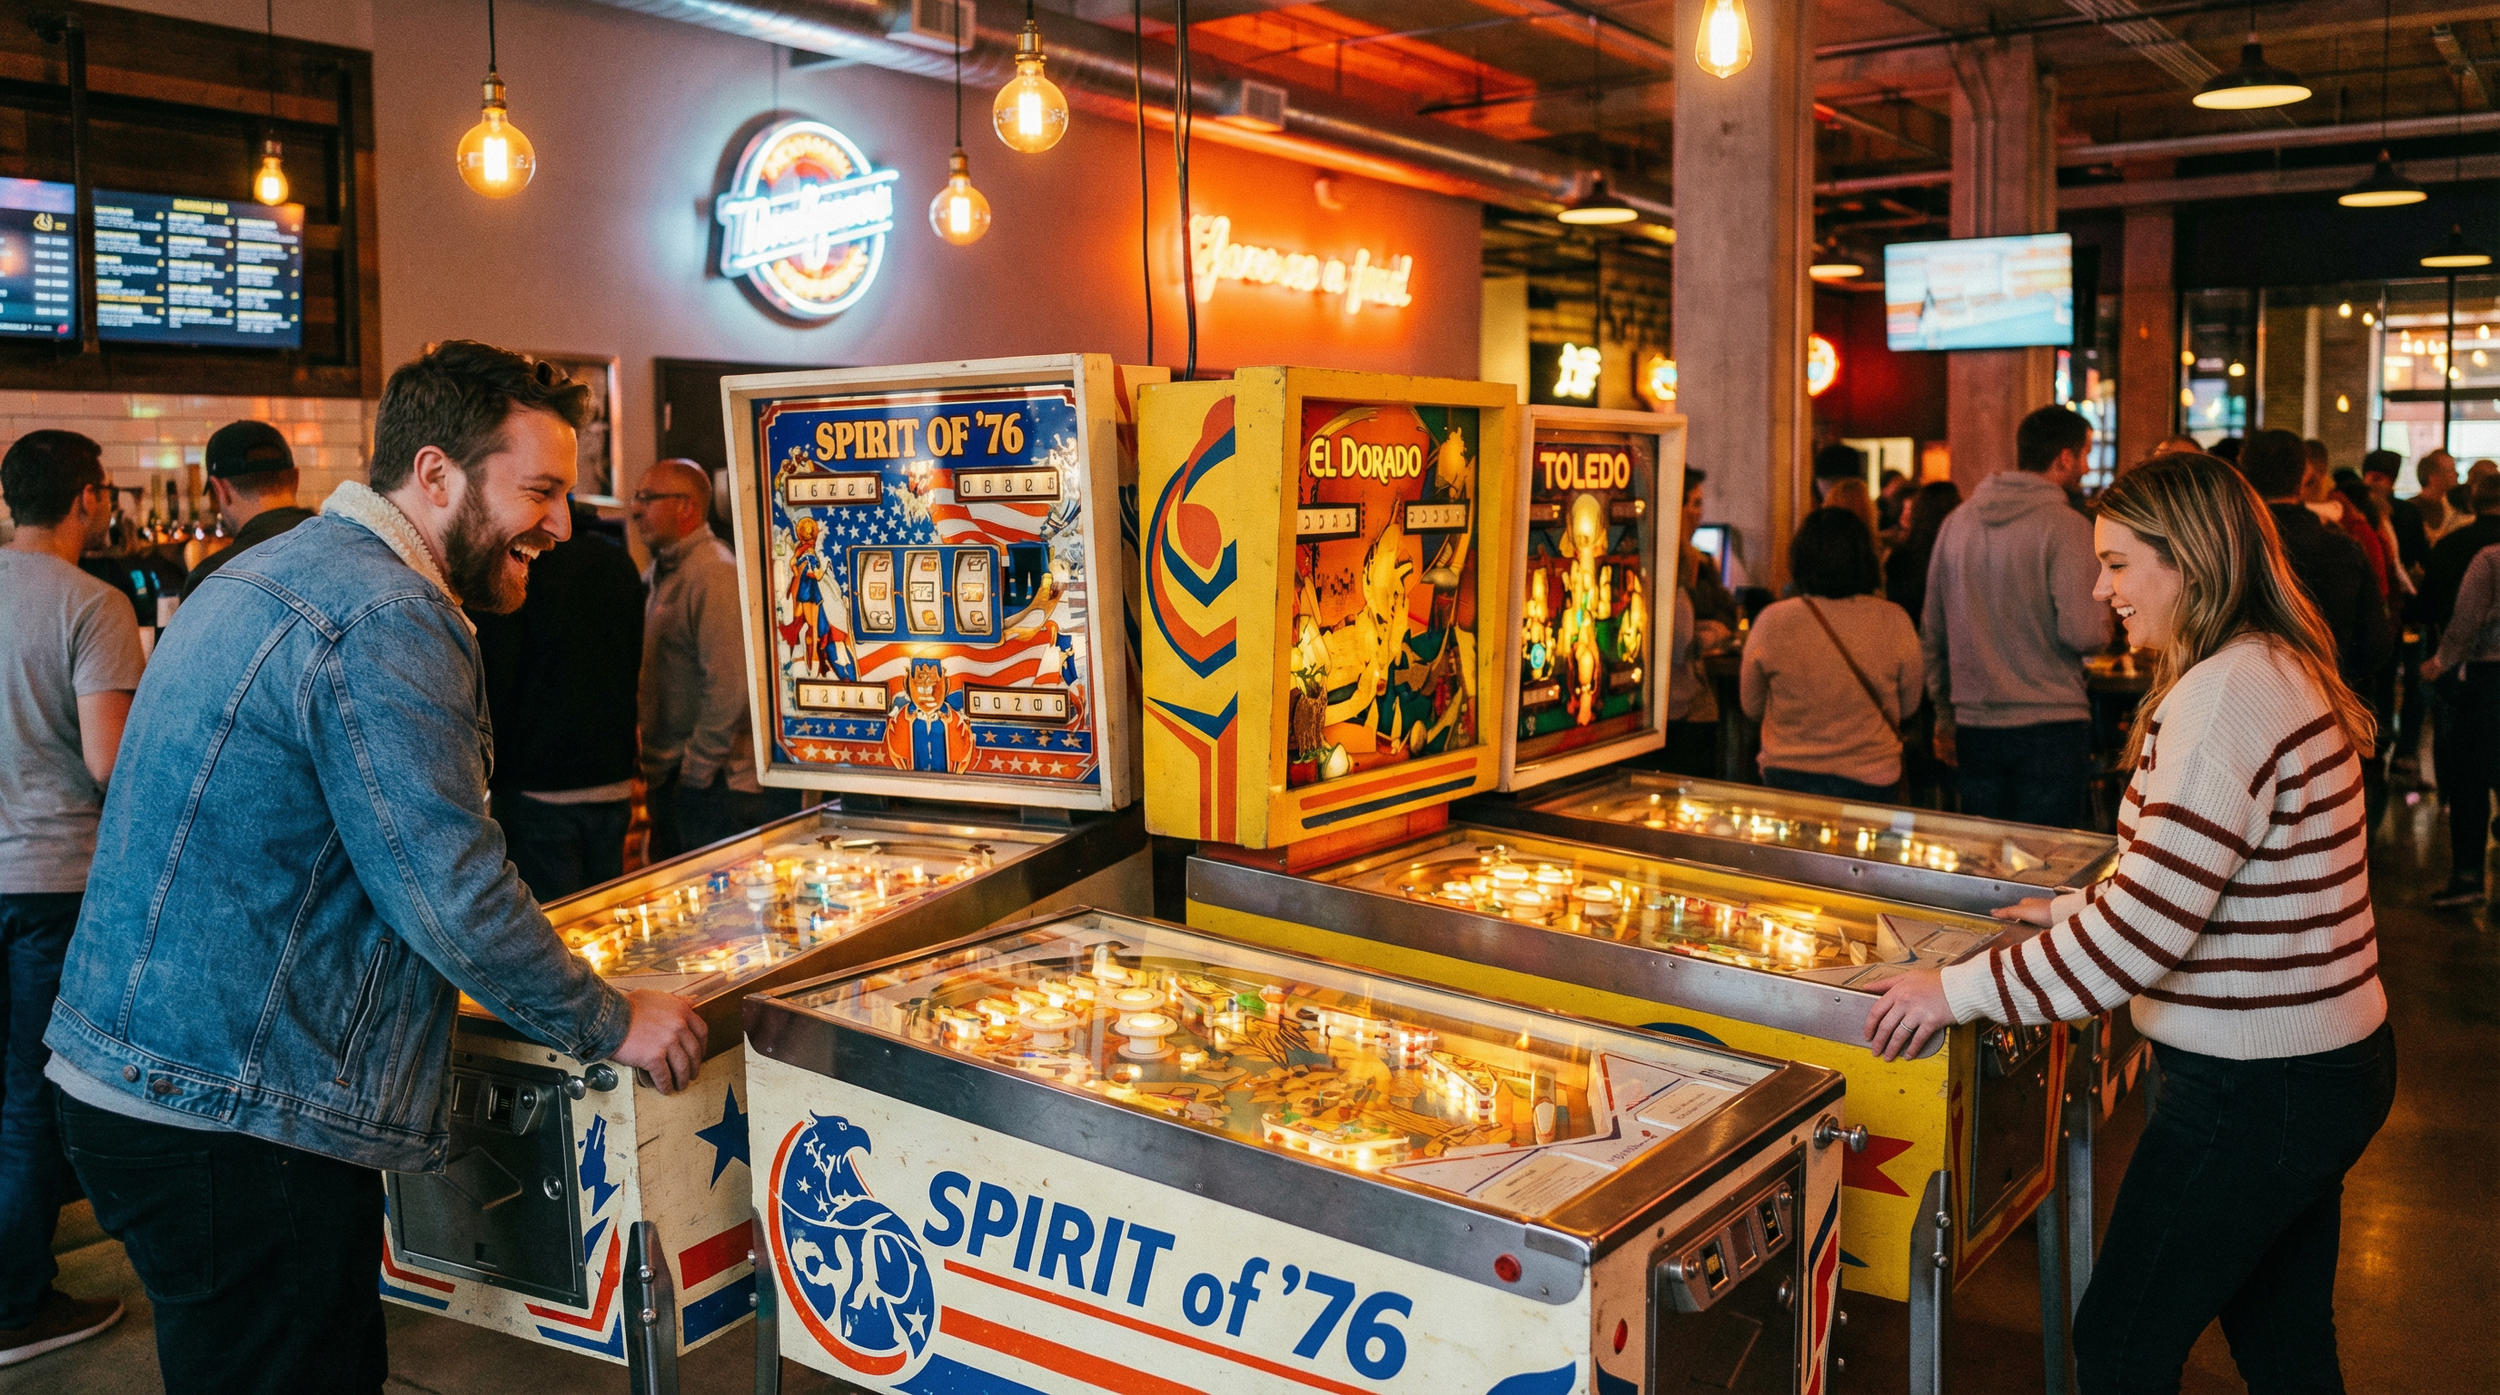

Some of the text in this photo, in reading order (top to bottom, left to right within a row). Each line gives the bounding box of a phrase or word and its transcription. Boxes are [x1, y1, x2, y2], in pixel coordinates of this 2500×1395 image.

[816, 410, 1024, 461] SPIRIT OF '76
[1309, 437, 1422, 484] EL DORADO
[1540, 451, 1630, 490] TOLEDO
[923, 1171, 1413, 1381] SPIRIT of '76
